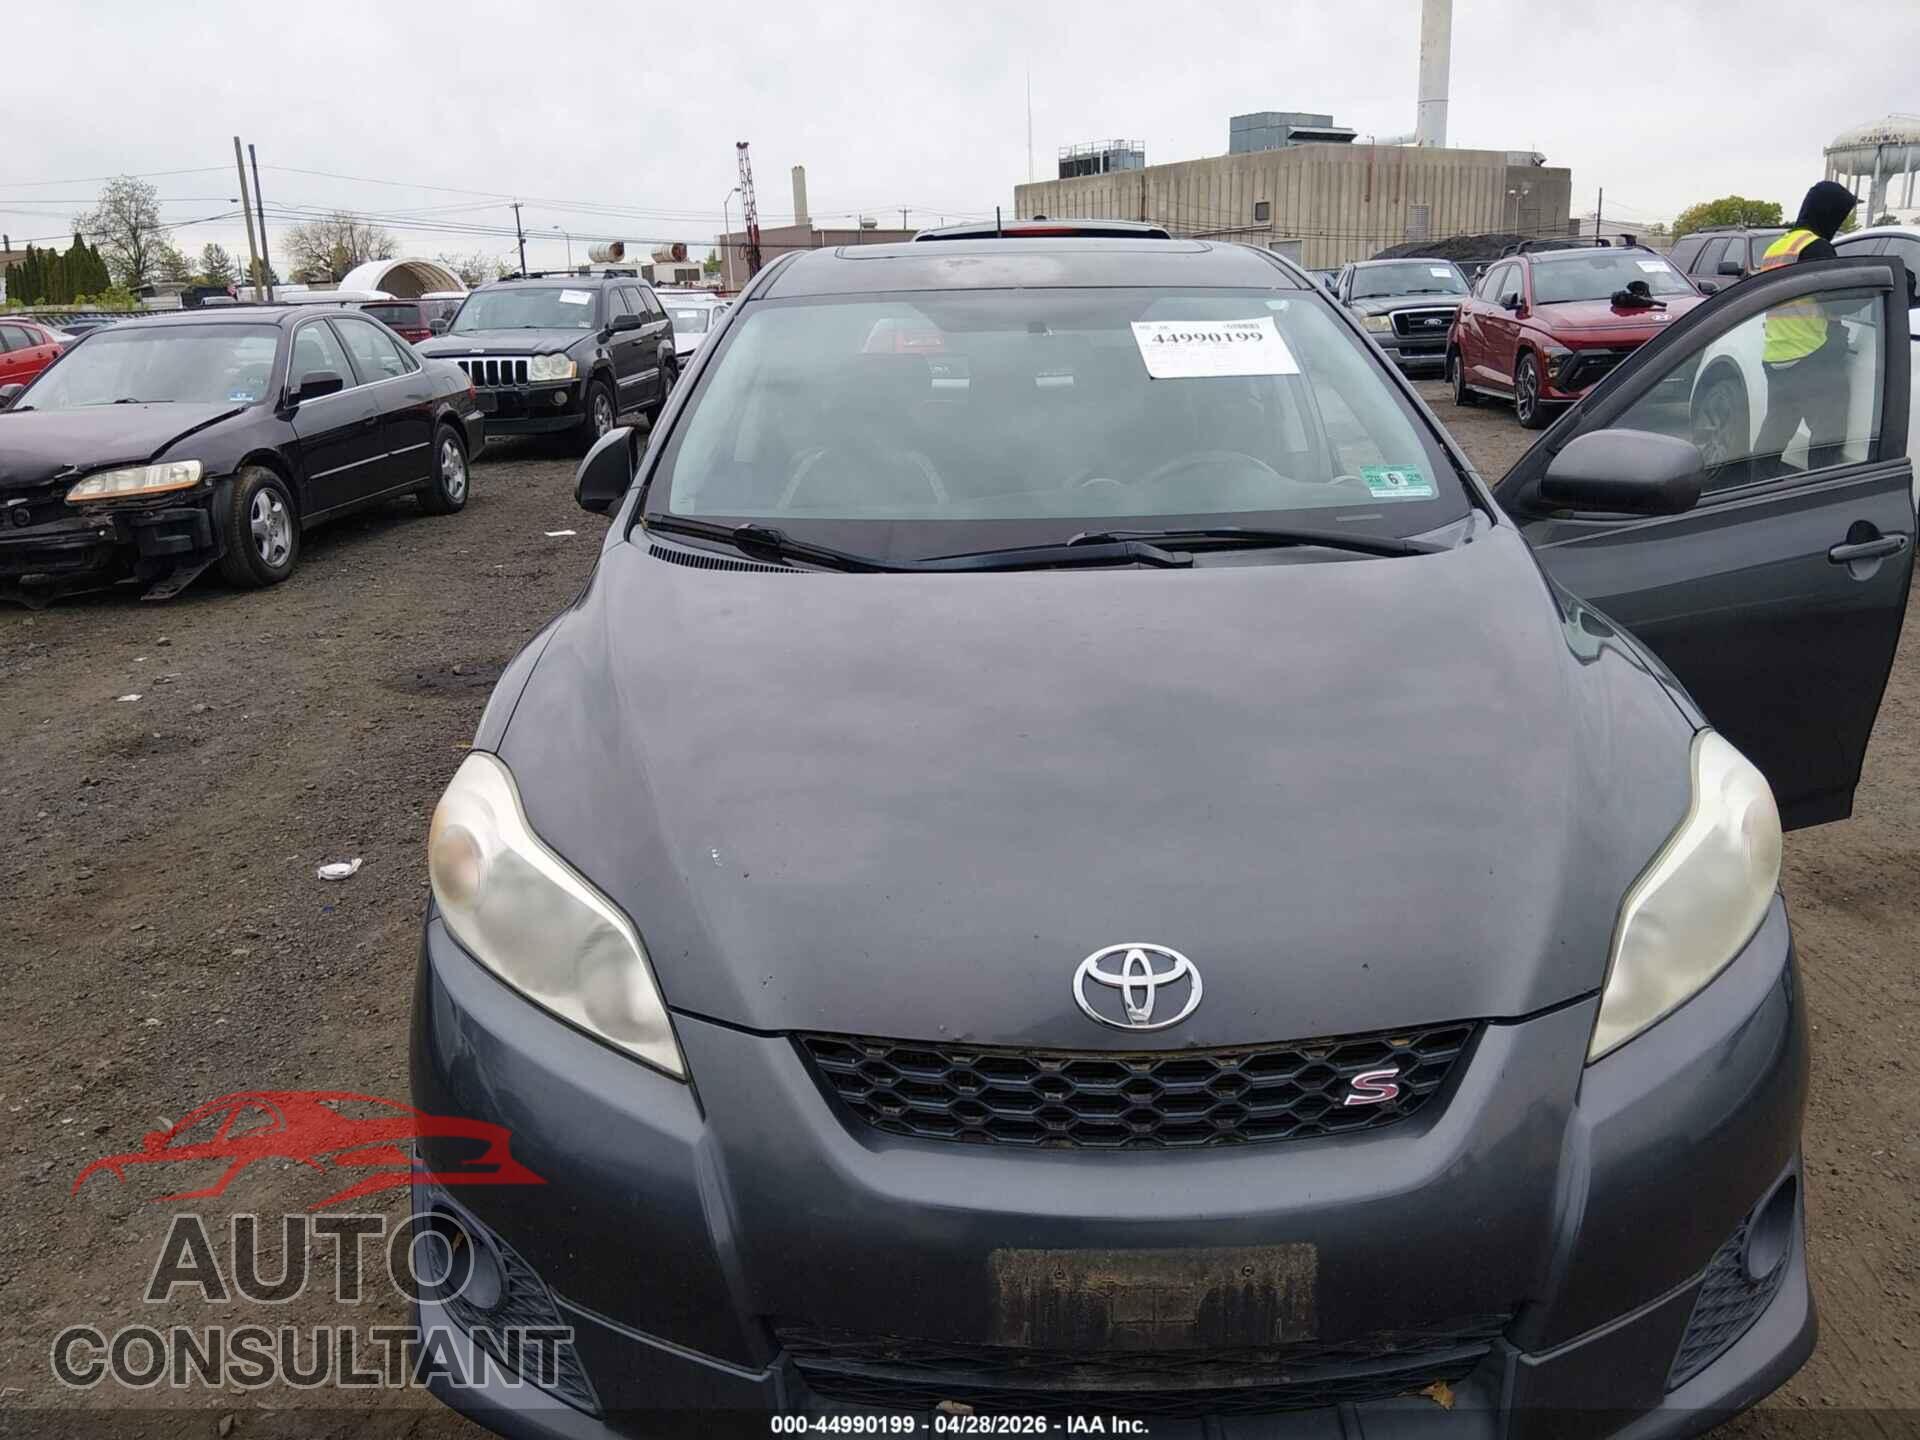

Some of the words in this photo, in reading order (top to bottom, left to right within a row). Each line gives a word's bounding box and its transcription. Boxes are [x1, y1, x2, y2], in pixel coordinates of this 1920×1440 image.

[1151, 331, 1264, 344] 44990199
[1387, 473, 1399, 485] 6
[1343, 1068, 1400, 1106] S
